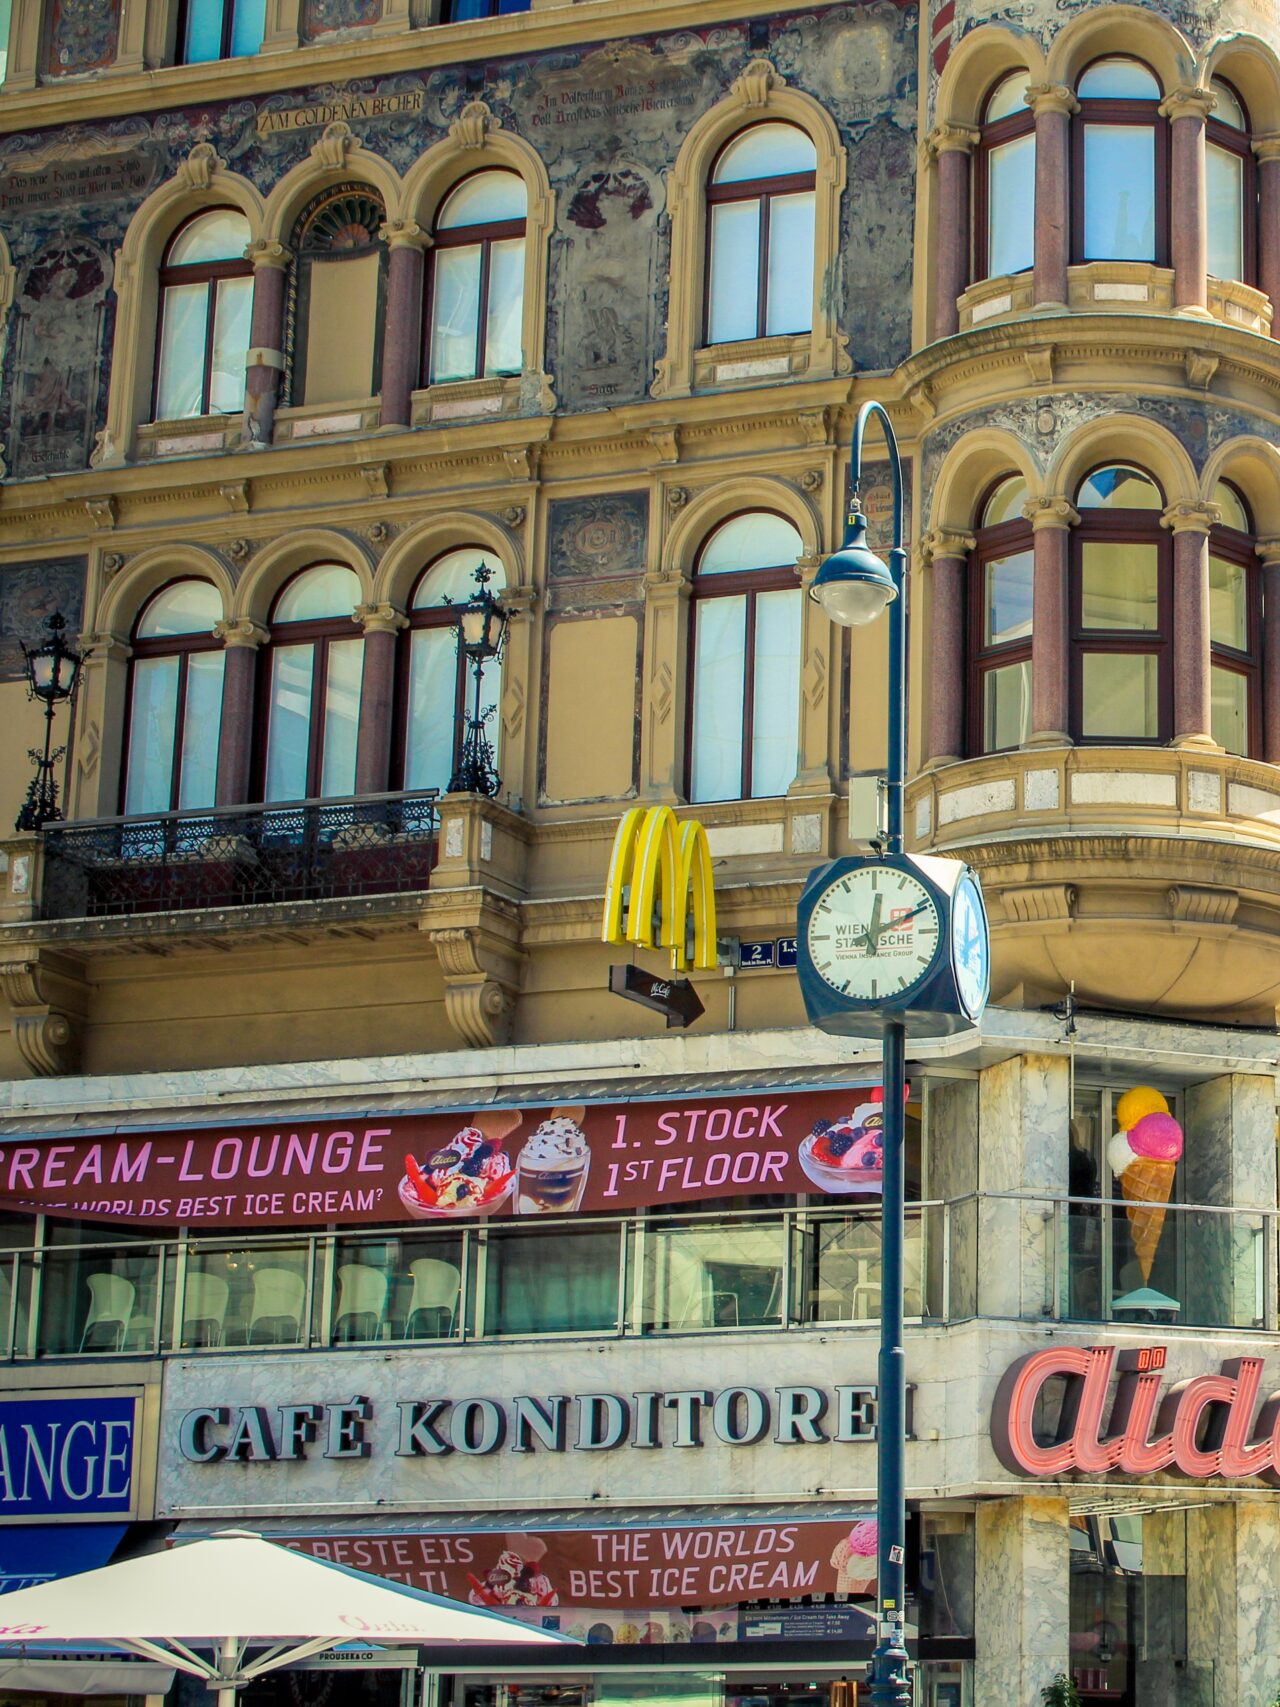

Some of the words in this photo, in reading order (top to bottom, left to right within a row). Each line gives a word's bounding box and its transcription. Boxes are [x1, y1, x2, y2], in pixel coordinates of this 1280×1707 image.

[295, 103, 368, 126] GOLDENEN
[372, 93, 422, 116] BECHER
[751, 945, 763, 960] 2
[655, 1104, 789, 1146] STOCK
[0, 1129, 392, 1190] REAM-LOUNGE
[657, 1151, 790, 1192] FLOOR
[176, 1195, 237, 1218] BEST
[243, 1193, 286, 1216] ICE
[179, 1394, 374, 1464] CAFÉ
[311, 1540, 409, 1566] BESTE
[420, 1538, 474, 1564] EIS
[591, 1533, 651, 1563] THE
[662, 1527, 798, 1561] WORLDS
[569, 1569, 640, 1598] BEST
[649, 1566, 700, 1597] ICE
[708, 1560, 820, 1594] CREAM
